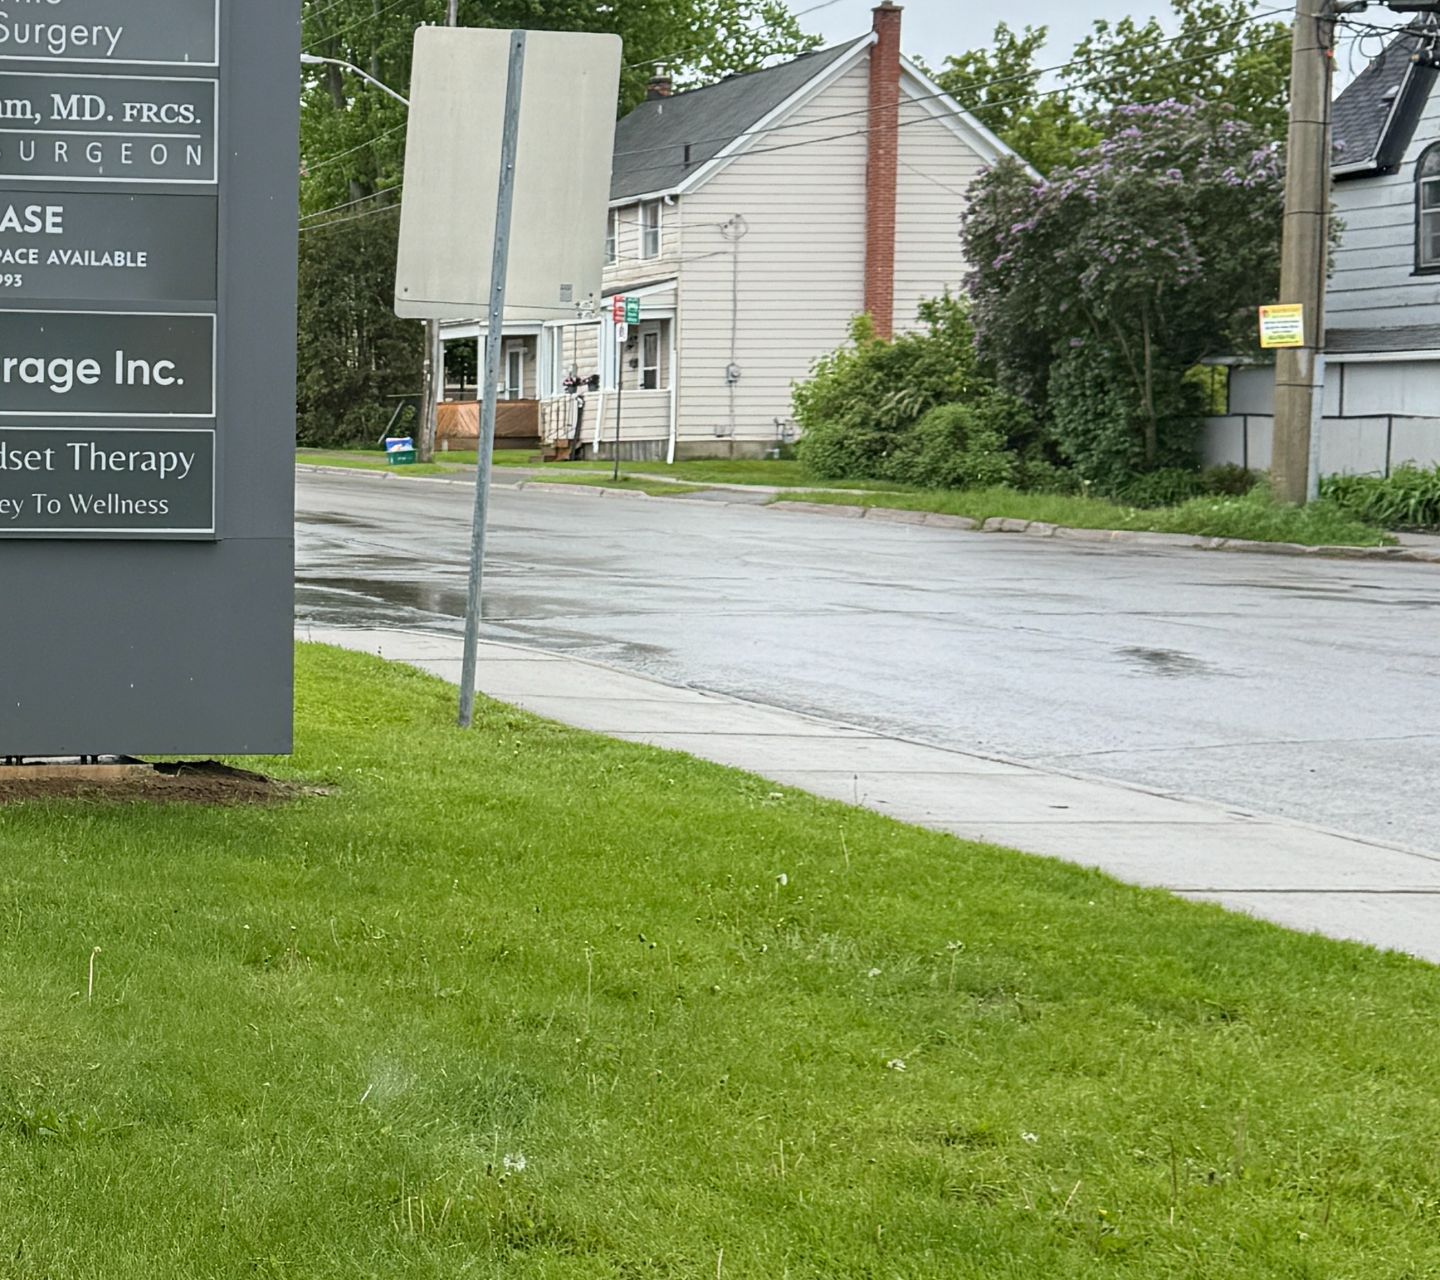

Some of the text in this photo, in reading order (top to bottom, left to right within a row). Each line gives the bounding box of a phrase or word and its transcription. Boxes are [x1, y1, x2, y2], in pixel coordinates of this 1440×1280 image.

[49, 93, 114, 122] MD.
[122, 102, 202, 124] FRCS.
[46, 249, 147, 268] AVAILABLE
[115, 350, 184, 386] Inc.
[66, 441, 195, 480] Therapy
[31, 493, 61, 514] To
[68, 493, 169, 515] Wellness
